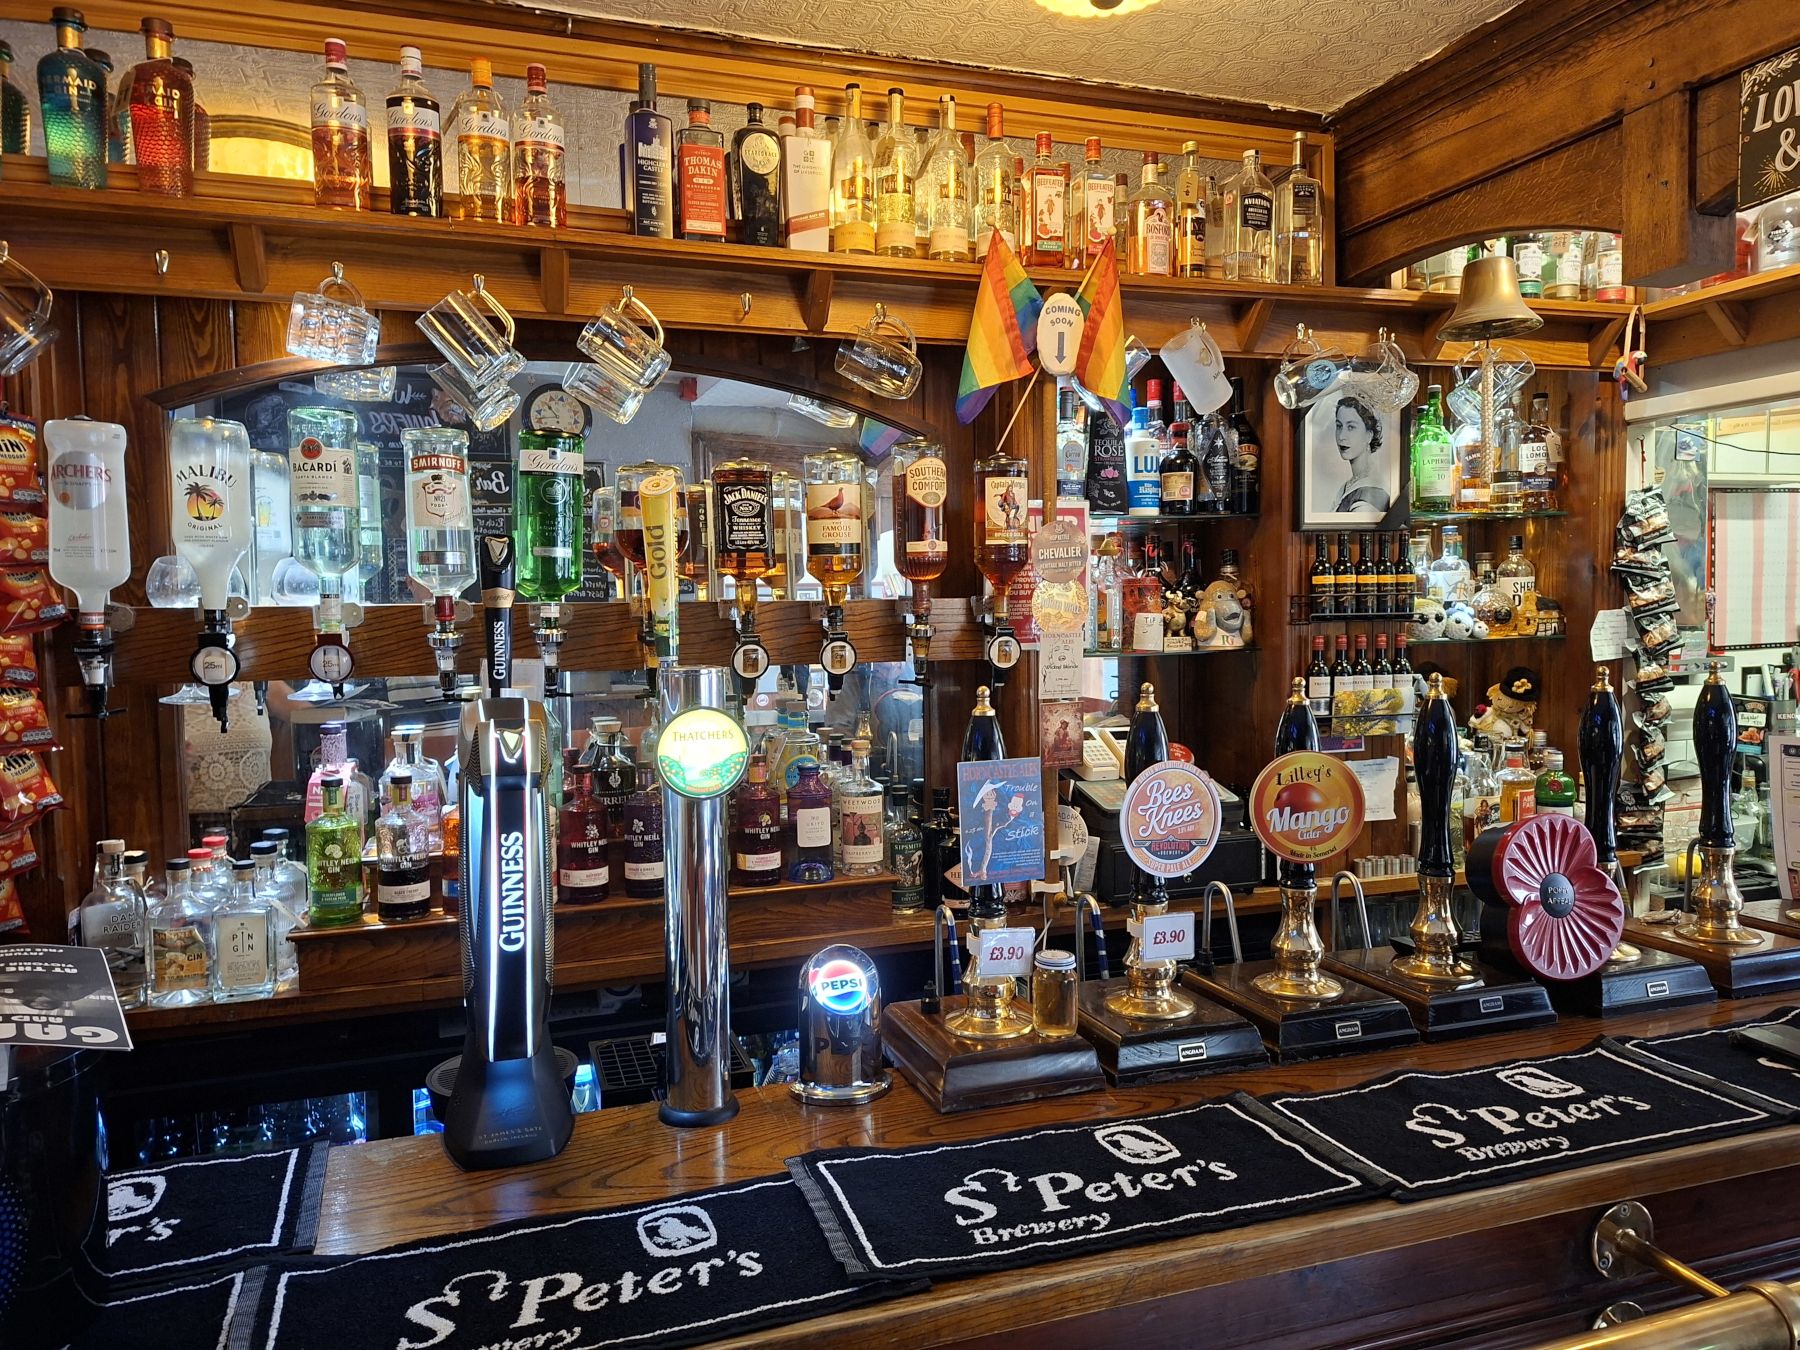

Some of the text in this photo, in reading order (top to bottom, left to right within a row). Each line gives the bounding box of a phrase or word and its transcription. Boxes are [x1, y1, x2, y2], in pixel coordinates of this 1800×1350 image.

[313, 102, 363, 123] Gordon's
[462, 117, 507, 138] Gordon's
[519, 121, 563, 144] Gordon's
[684, 156, 722, 169] THOMAS
[688, 166, 718, 176] DAKIN
[1036, 178, 1063, 187] BEEFEATER
[1087, 183, 1115, 193] BEEFEATER
[1045, 305, 1081, 317] COMING
[1050, 317, 1074, 328] SOON
[1094, 439, 1124, 447] TEQUILA
[1094, 446, 1124, 458] ROSE
[528, 454, 579, 473] Gordon's
[51, 464, 112, 483] ARCHERS
[176, 464, 238, 488] MALIBU
[724, 488, 769, 506] JACK DANIEL'S
[188, 522, 223, 532] ORIGINAL
[646, 524, 668, 580] Gold
[1038, 546, 1082, 560] CHEVALIER
[493, 620, 505, 680] GUINNESS
[204, 660, 223, 670] 25ml
[673, 730, 735, 742] THATCHERS
[1276, 764, 1332, 786] Lilley's
[1138, 779, 1194, 813] Bees
[1139, 802, 1204, 838] Knees
[1266, 806, 1350, 833] Mango
[760, 833, 771, 841] GIN
[1298, 829, 1322, 840] Cider
[571, 840, 598, 849] WHITLEY
[1151, 841, 1190, 852] REVOLUTION
[1290, 849, 1305, 858] Made
[1313, 845, 1338, 859] Somerset
[328, 866, 341, 874] GIN
[1146, 858, 1193, 873] SUPER PALE ALE
[499, 830, 524, 952] GUINNESS
[111, 912, 136, 924] DAM
[103, 920, 142, 934] RAIDER
[1153, 929, 1186, 945] £3.90
[989, 946, 1025, 962] £3.90
[821, 978, 863, 991] PEPSI
[1467, 1094, 1653, 1135] Peter's
[1454, 1134, 1571, 1162] Brewery
[1027, 1159, 1238, 1213] Peter's
[968, 1212, 1111, 1246] Brewery
[509, 1250, 764, 1330] Peter's
